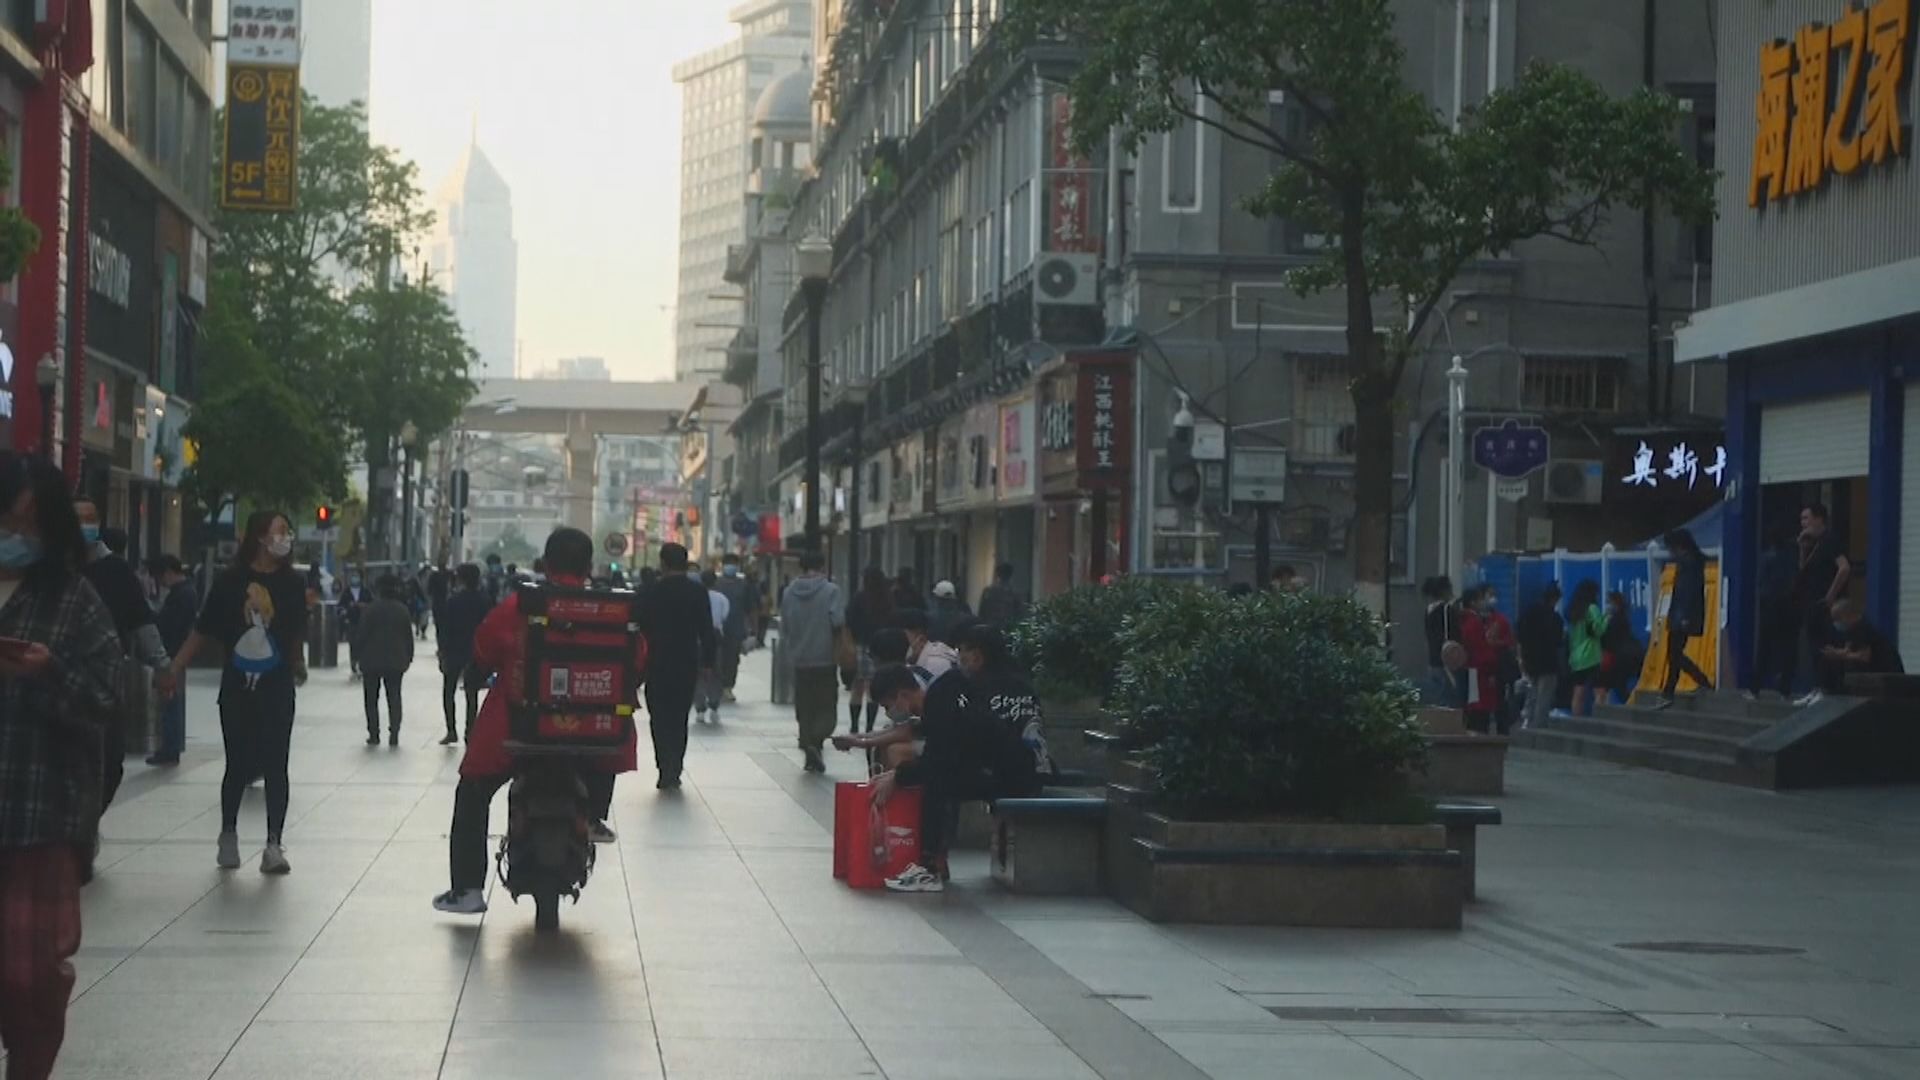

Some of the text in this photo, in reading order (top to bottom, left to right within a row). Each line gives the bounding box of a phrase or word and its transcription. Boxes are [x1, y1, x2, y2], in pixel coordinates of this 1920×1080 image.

[1747, 0, 1910, 208] 海澜之家
[232, 162, 260, 184] 5F
[1092, 373, 1115, 468] 江西桃酥王
